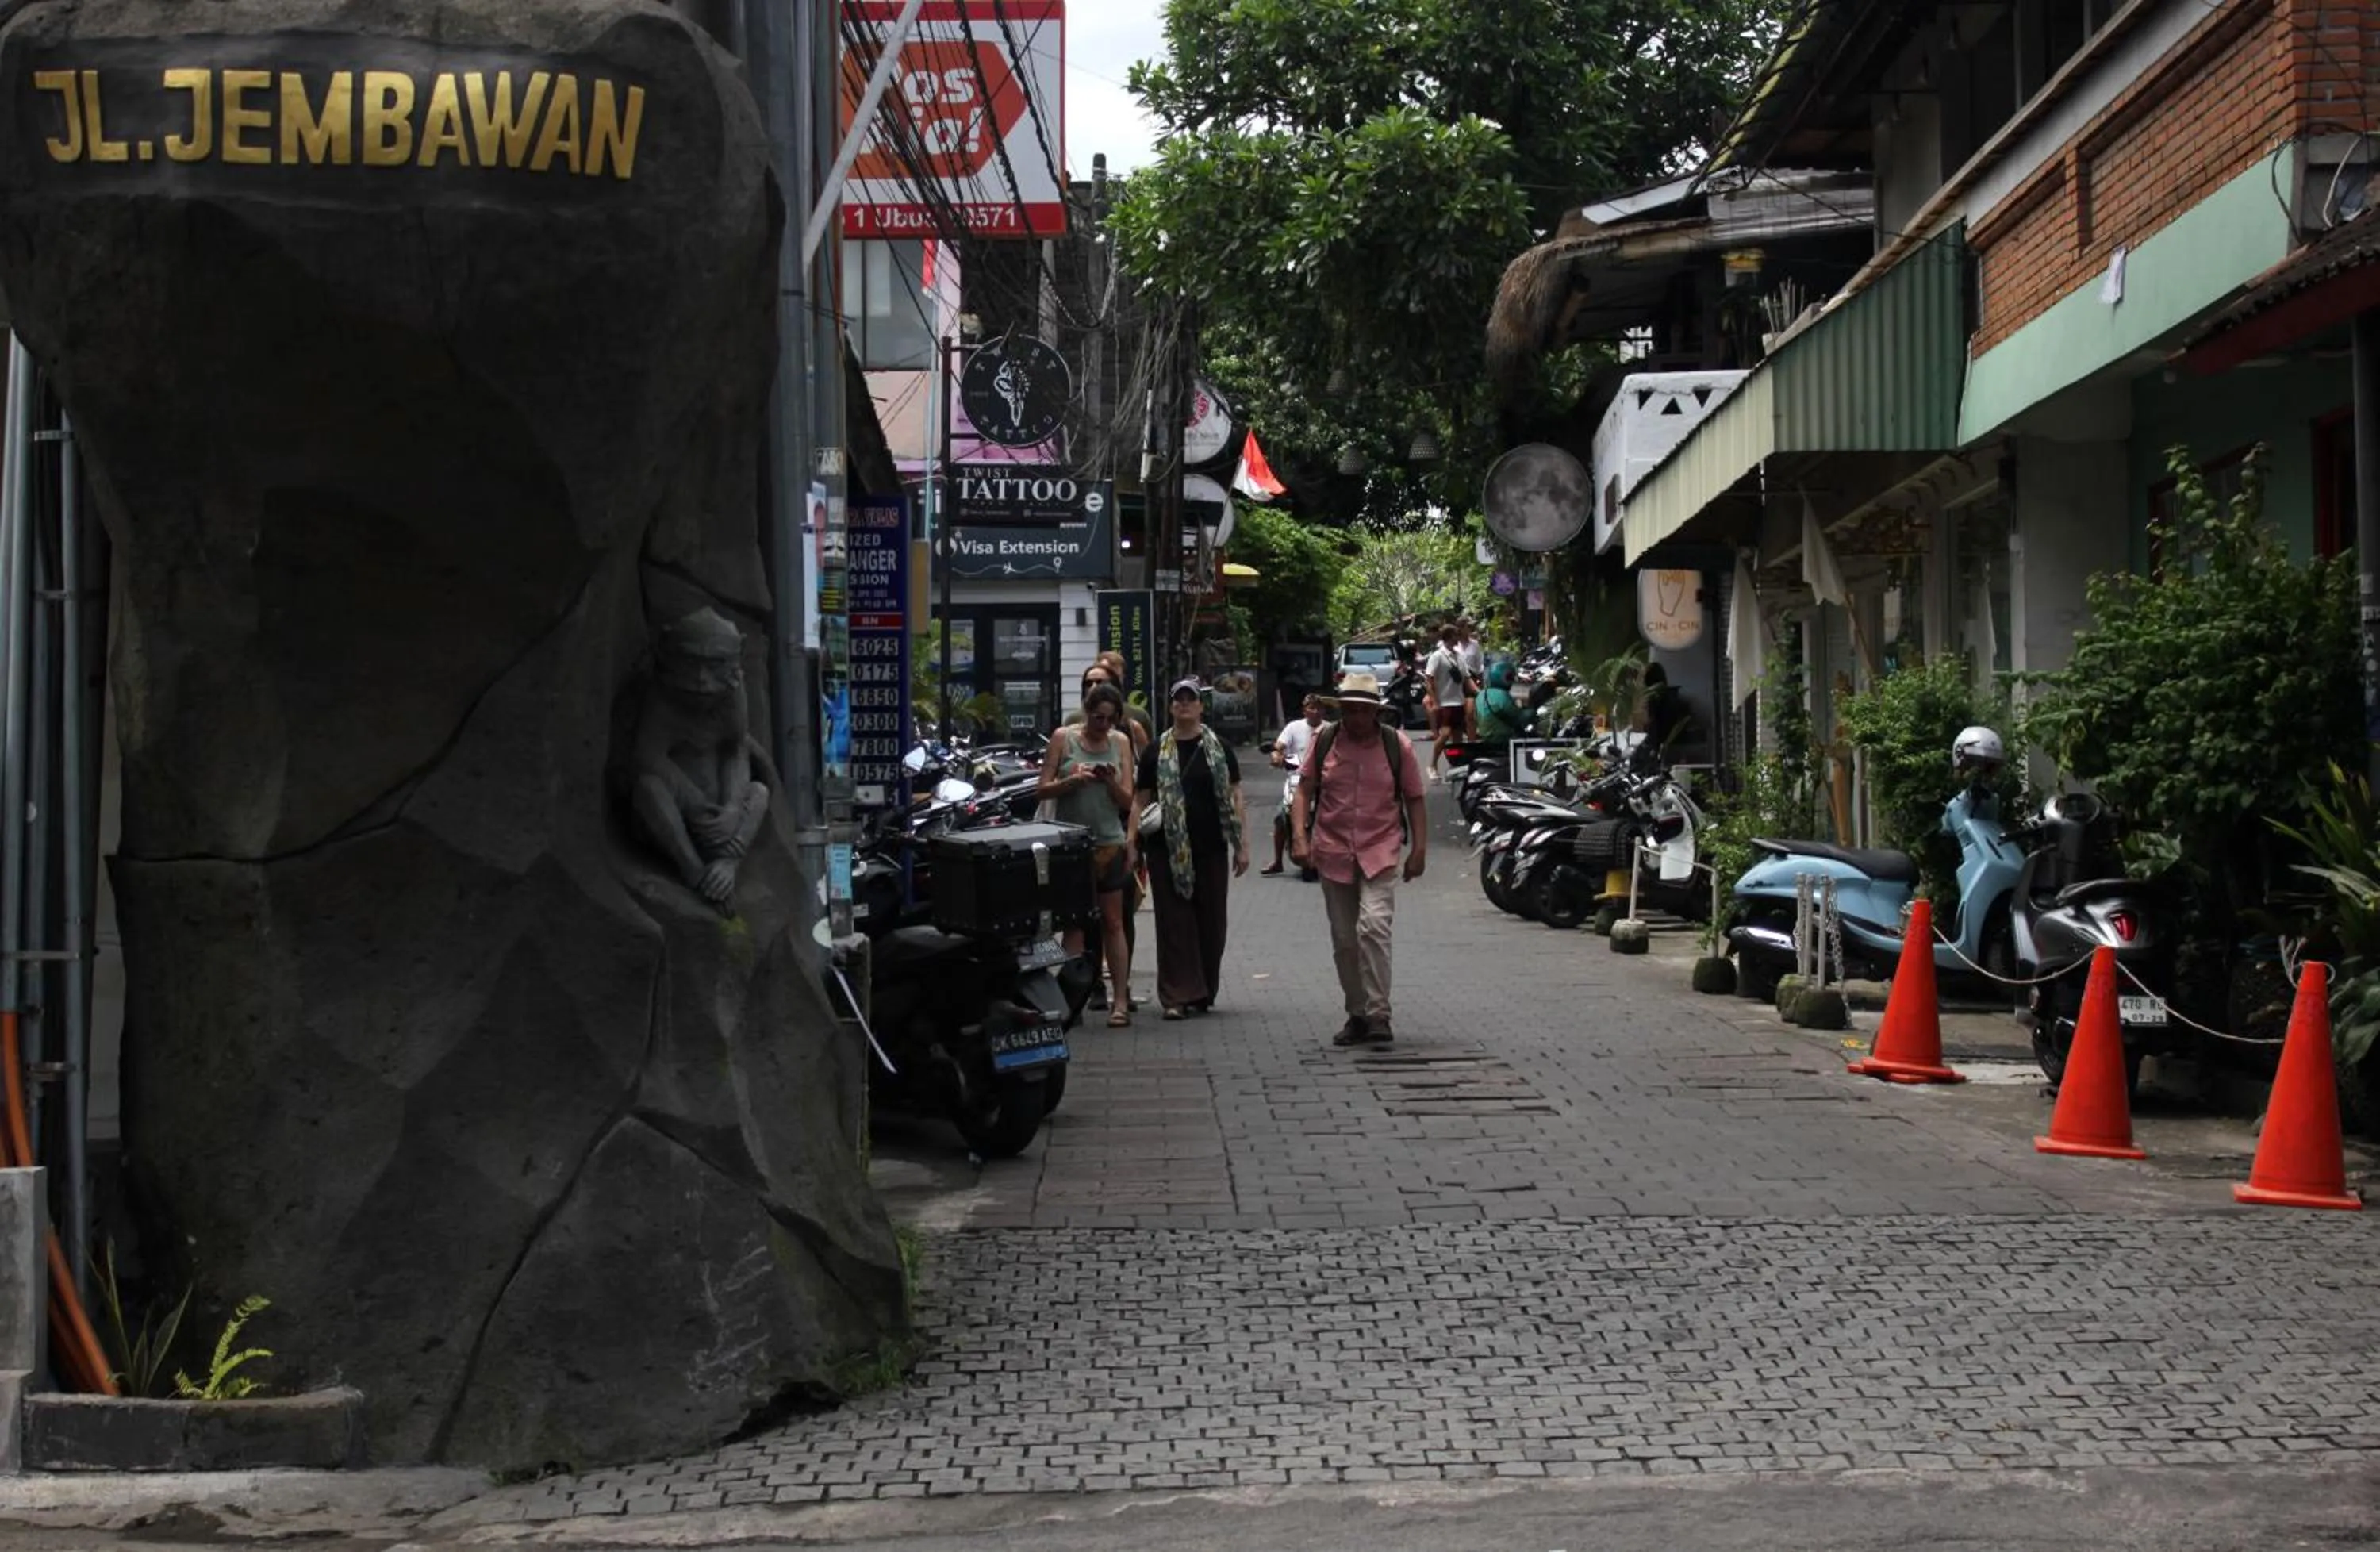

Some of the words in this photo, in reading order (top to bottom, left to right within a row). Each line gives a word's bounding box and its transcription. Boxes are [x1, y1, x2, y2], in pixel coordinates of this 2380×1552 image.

[854, 207, 865, 228] 1
[962, 467, 1012, 478] TWIST
[956, 478, 1077, 501] TATTOO
[959, 540, 994, 555] Visa
[1000, 539, 1080, 555] Extension
